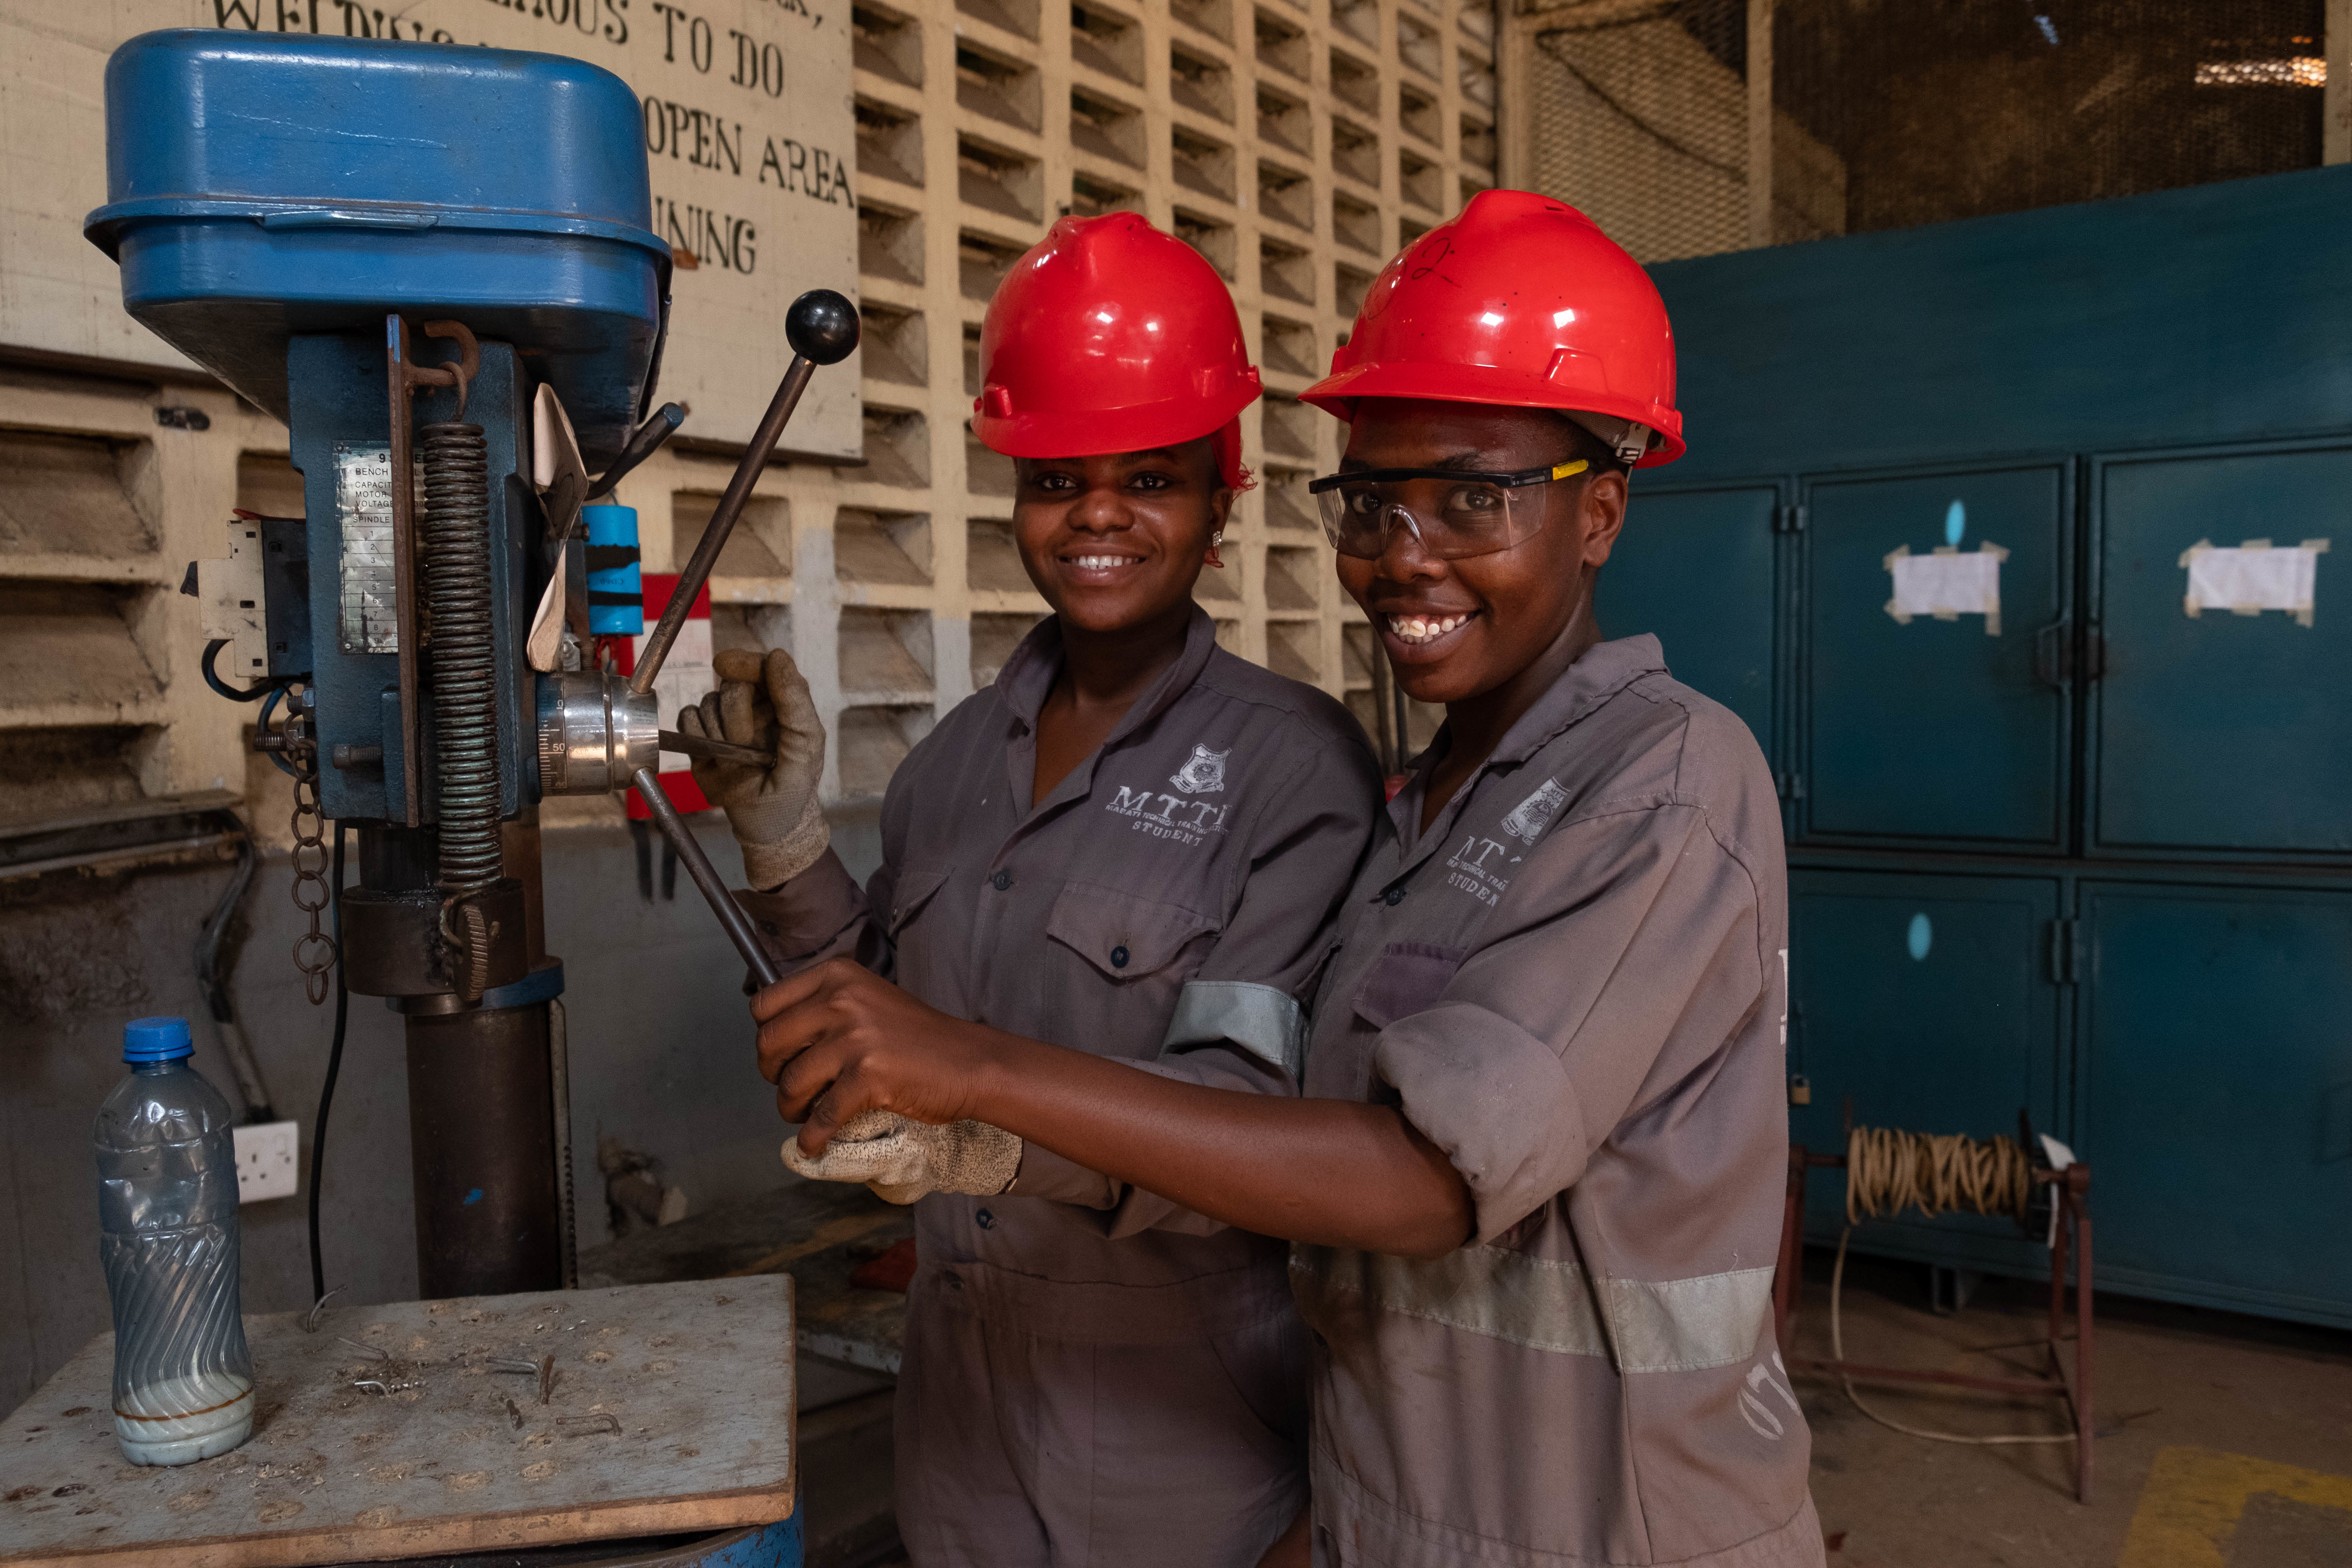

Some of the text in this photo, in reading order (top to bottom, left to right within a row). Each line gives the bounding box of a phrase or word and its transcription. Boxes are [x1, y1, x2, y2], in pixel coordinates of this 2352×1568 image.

[653, 2, 712, 74] TO
[728, 29, 783, 99] DO
[643, 96, 741, 176] OPEN
[759, 135, 855, 209] AREA
[379, 454, 386, 463] 9
[552, 743, 565, 751] 50
[1105, 804, 1141, 817] MABATI
[1132, 821, 1203, 846] STUDENT
[1448, 872, 1500, 907] STUDEN
